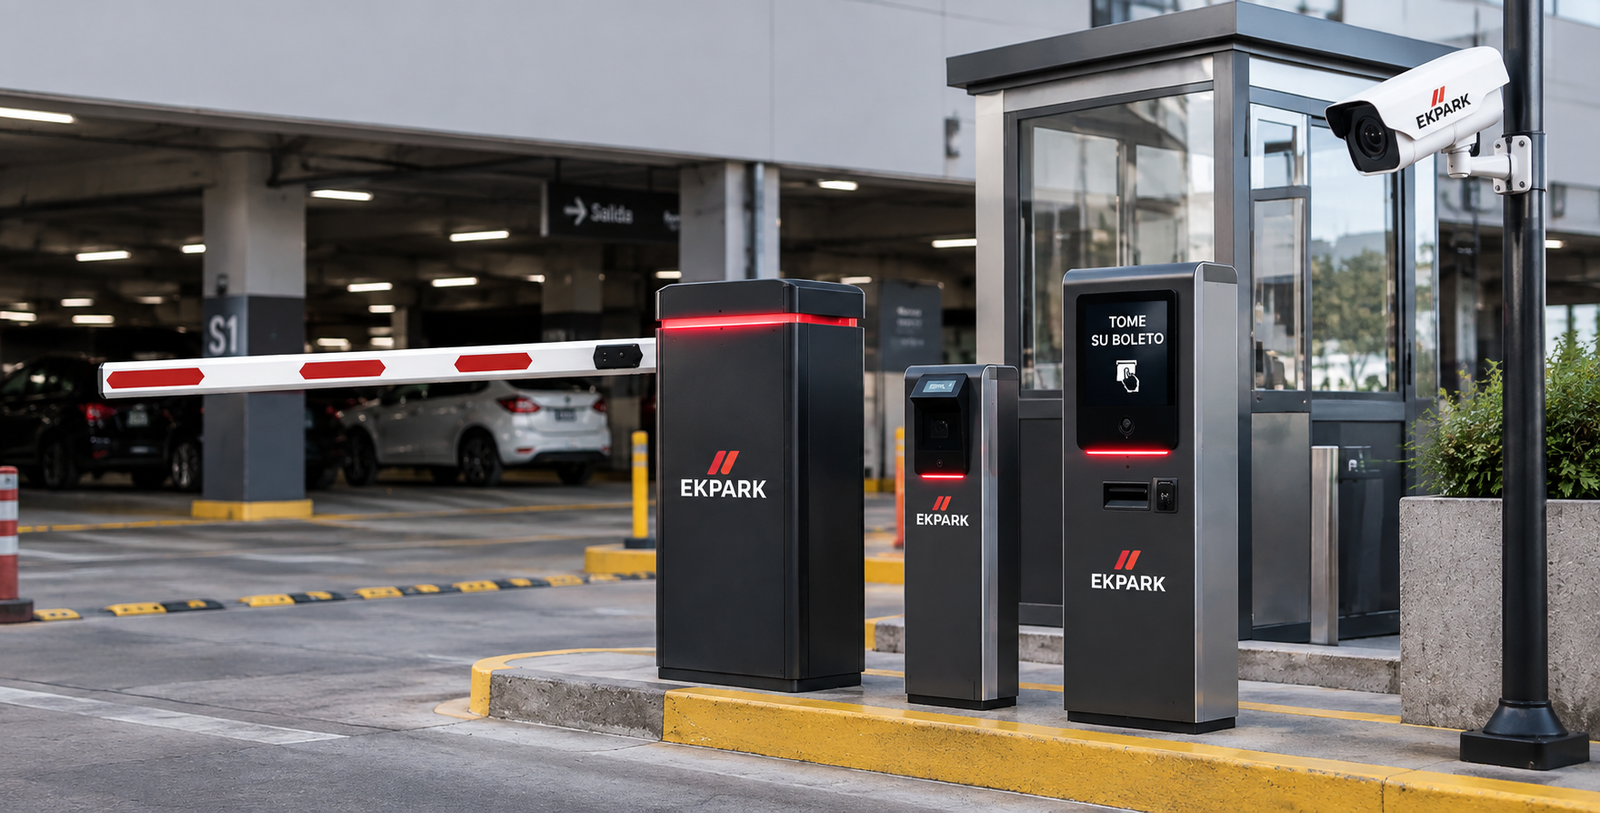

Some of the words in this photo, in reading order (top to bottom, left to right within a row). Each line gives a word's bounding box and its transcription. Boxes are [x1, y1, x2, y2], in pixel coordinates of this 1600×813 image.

[1416, 93, 1471, 129] EKPARK
[1108, 314, 1147, 329] TOME
[208, 314, 238, 355] S1
[1091, 334, 1109, 347] SU
[1112, 332, 1165, 346] BOLETO
[680, 478, 767, 499] EKPARK
[916, 512, 970, 527] EKPARK
[1091, 572, 1166, 593] EKPARK
